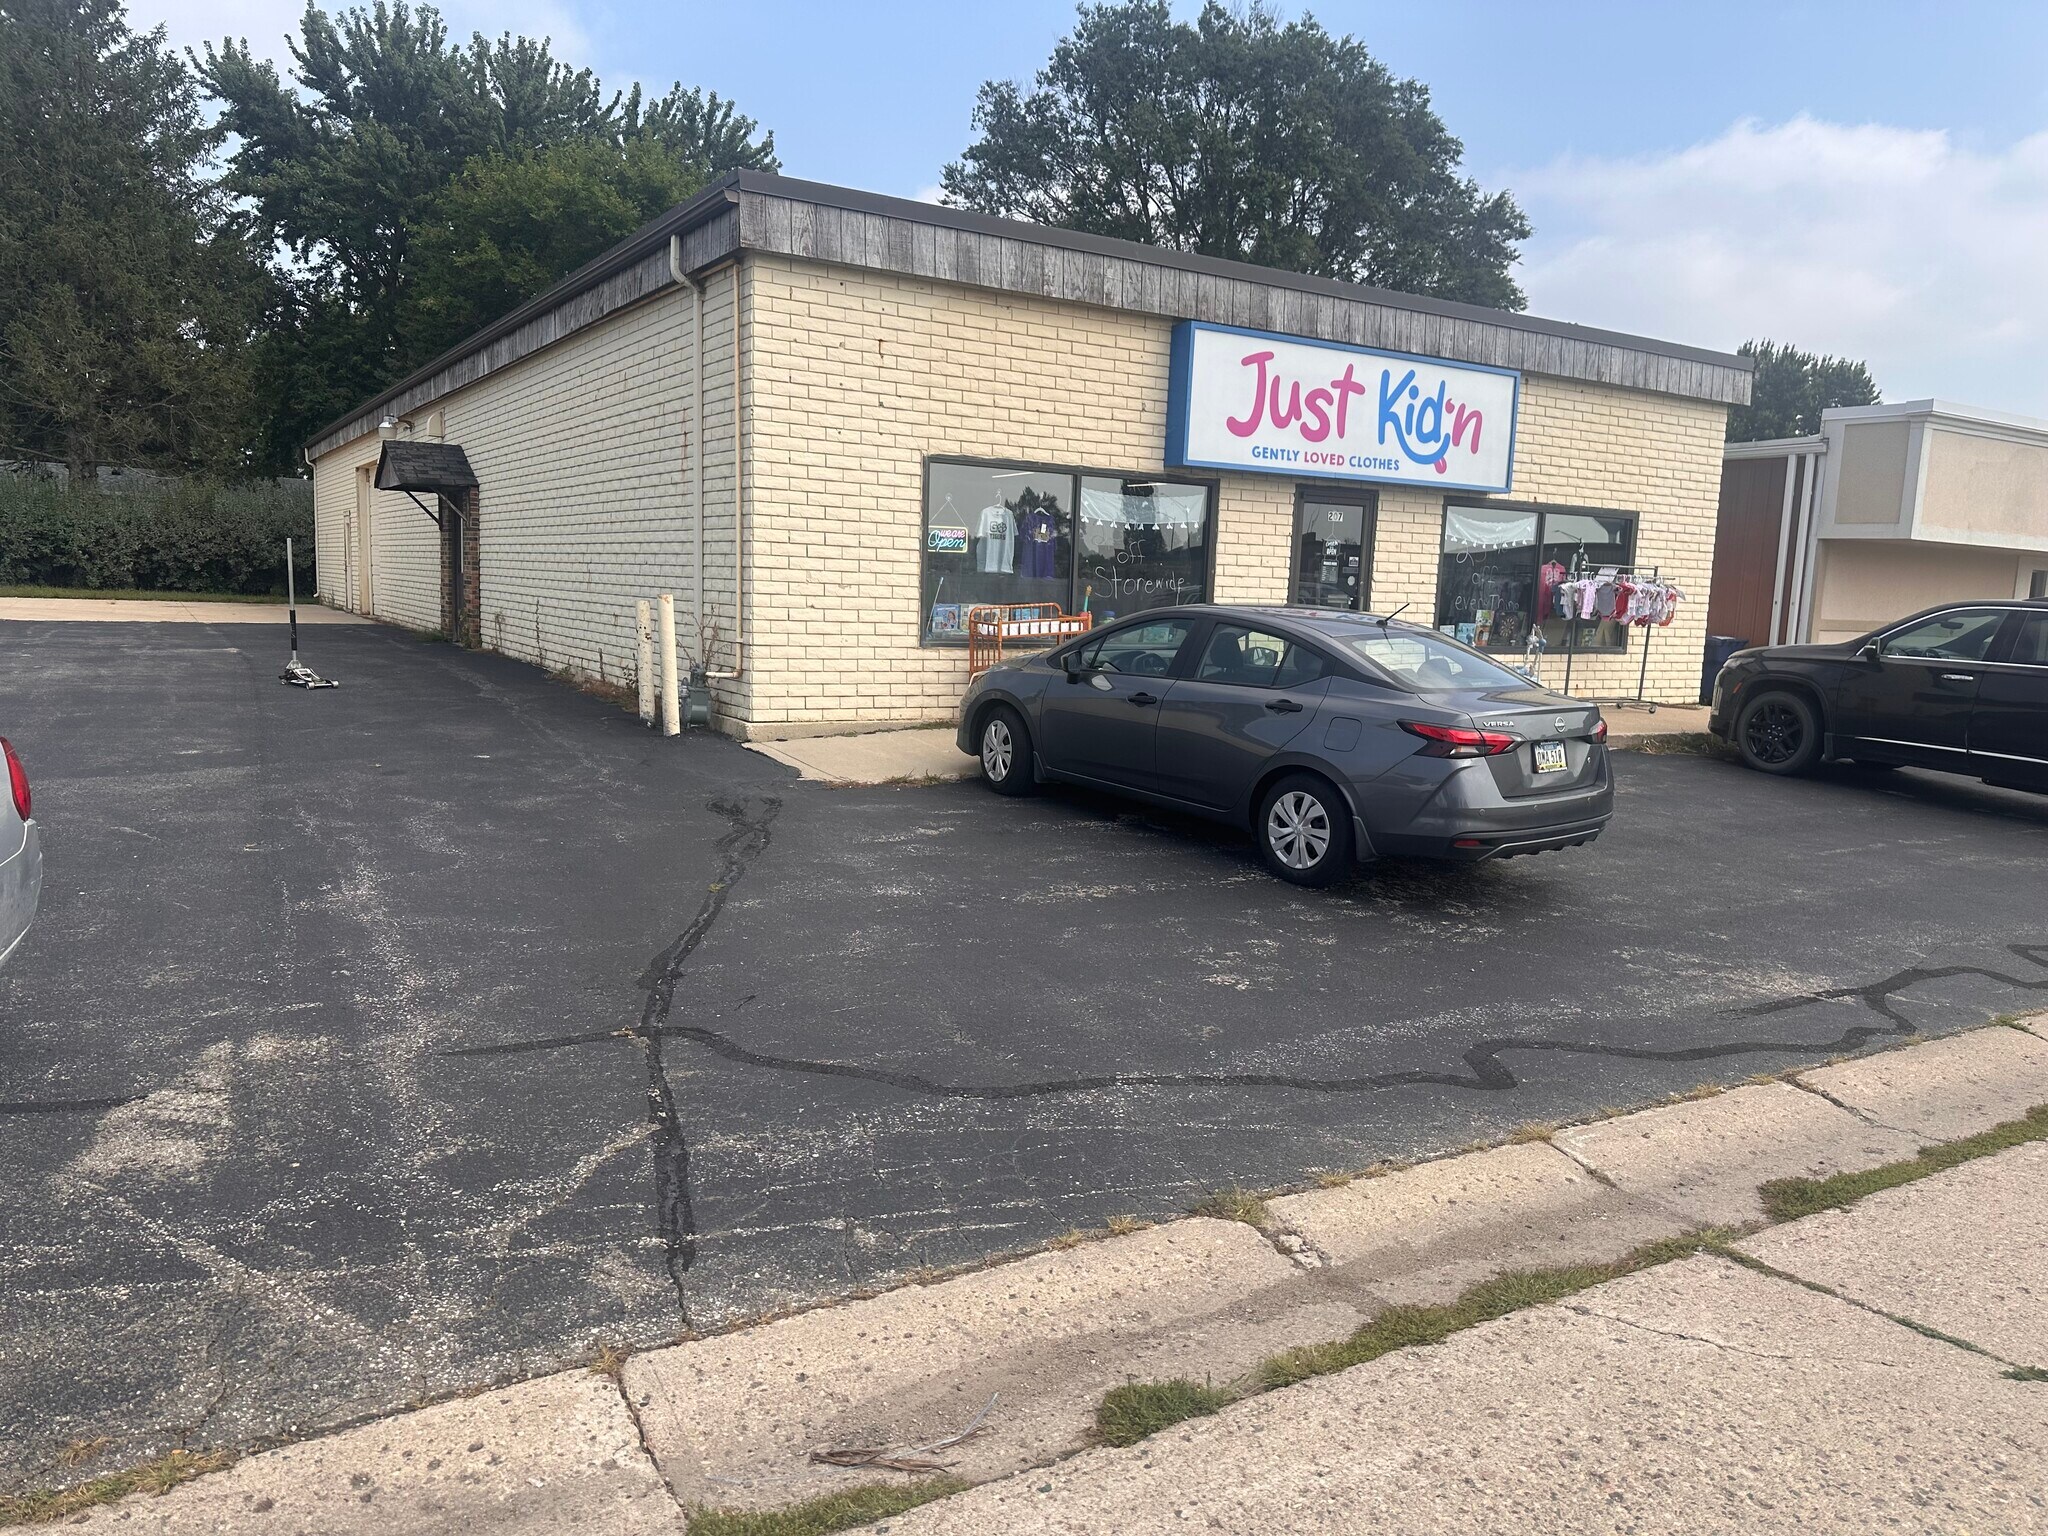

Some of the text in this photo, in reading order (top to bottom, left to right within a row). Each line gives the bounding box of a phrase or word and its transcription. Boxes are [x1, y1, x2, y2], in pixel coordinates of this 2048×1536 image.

[1226, 351, 1482, 465] Just Kid'n
[1252, 446, 1400, 471] GENTLY LOVED CLOTHES
[1328, 512, 1343, 521] 207
[928, 530, 966, 551] Open
[1117, 540, 1146, 565] off
[1095, 565, 1185, 600] Storewide
[1472, 565, 1499, 589] off
